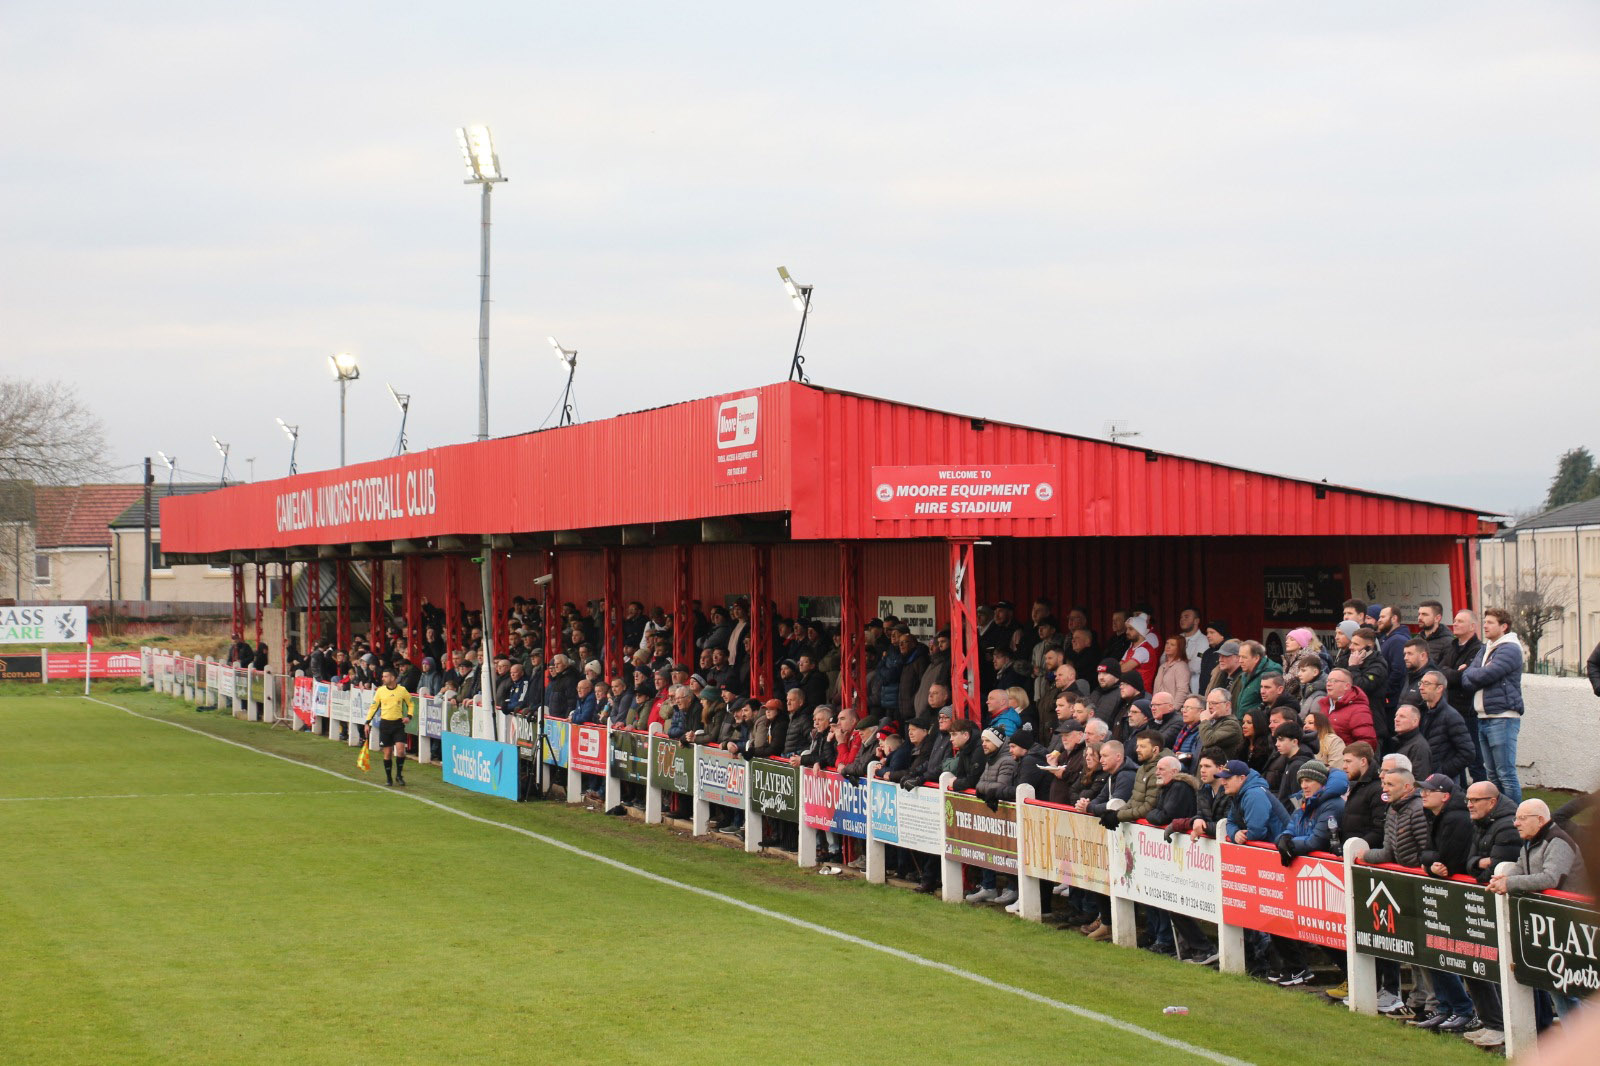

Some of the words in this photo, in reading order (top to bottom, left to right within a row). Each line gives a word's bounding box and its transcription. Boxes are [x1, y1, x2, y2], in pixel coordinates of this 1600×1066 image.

[939, 470, 978, 480] WELCOME
[981, 470, 992, 478] TO
[276, 488, 313, 532] CAMELON
[316, 481, 350, 528] JUNIORS
[352, 473, 404, 522] FOOTBALL
[406, 468, 436, 517] CLUB
[896, 484, 948, 497] MOORE
[951, 484, 1030, 499] EQUIPMENT
[914, 502, 948, 514] HIRE
[951, 501, 1012, 514] STADIUM
[0, 626, 44, 639] ARE
[452, 744, 475, 780] Scottish
[478, 750, 491, 783] Gas
[755, 769, 792, 796] PLAYERS
[776, 794, 787, 813] Bar
[804, 774, 832, 809] DONNYS
[834, 780, 867, 816] CARPETS
[956, 811, 972, 828] TREE
[973, 814, 1006, 836] ARBORIST
[1081, 840, 1109, 871] AESTHETIC
[1138, 831, 1171, 861] Flowers
[1174, 843, 1184, 872] by
[1186, 843, 1214, 872] Aileen
[1149, 887, 1161, 899] 01324
[1186, 897, 1198, 909] 01324
[1298, 915, 1347, 934] IRONWORKS
[1299, 930, 1324, 944] BUSINESS
[1327, 936, 1347, 948] CENTR
[1357, 930, 1371, 947] HOME
[1530, 913, 1600, 960] PLAY
[1548, 953, 1600, 993] Sports
